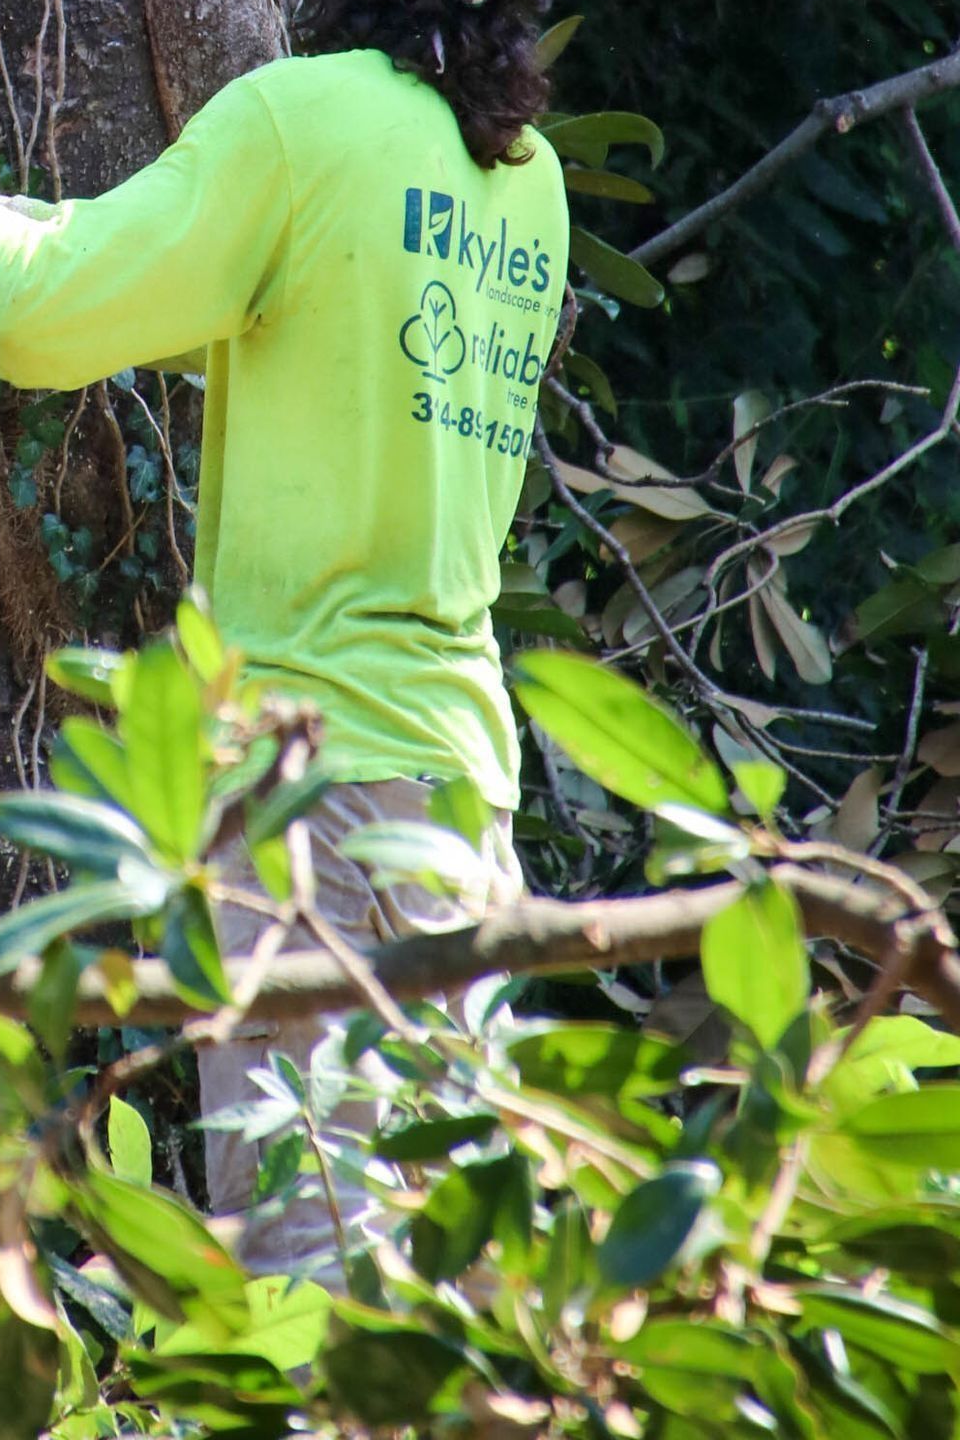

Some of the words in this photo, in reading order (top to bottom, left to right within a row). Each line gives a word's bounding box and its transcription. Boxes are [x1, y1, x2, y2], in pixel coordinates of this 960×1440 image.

[458, 200, 550, 293] kyle's
[486, 280, 541, 315] landscape
[471, 321, 545, 386] reliab
